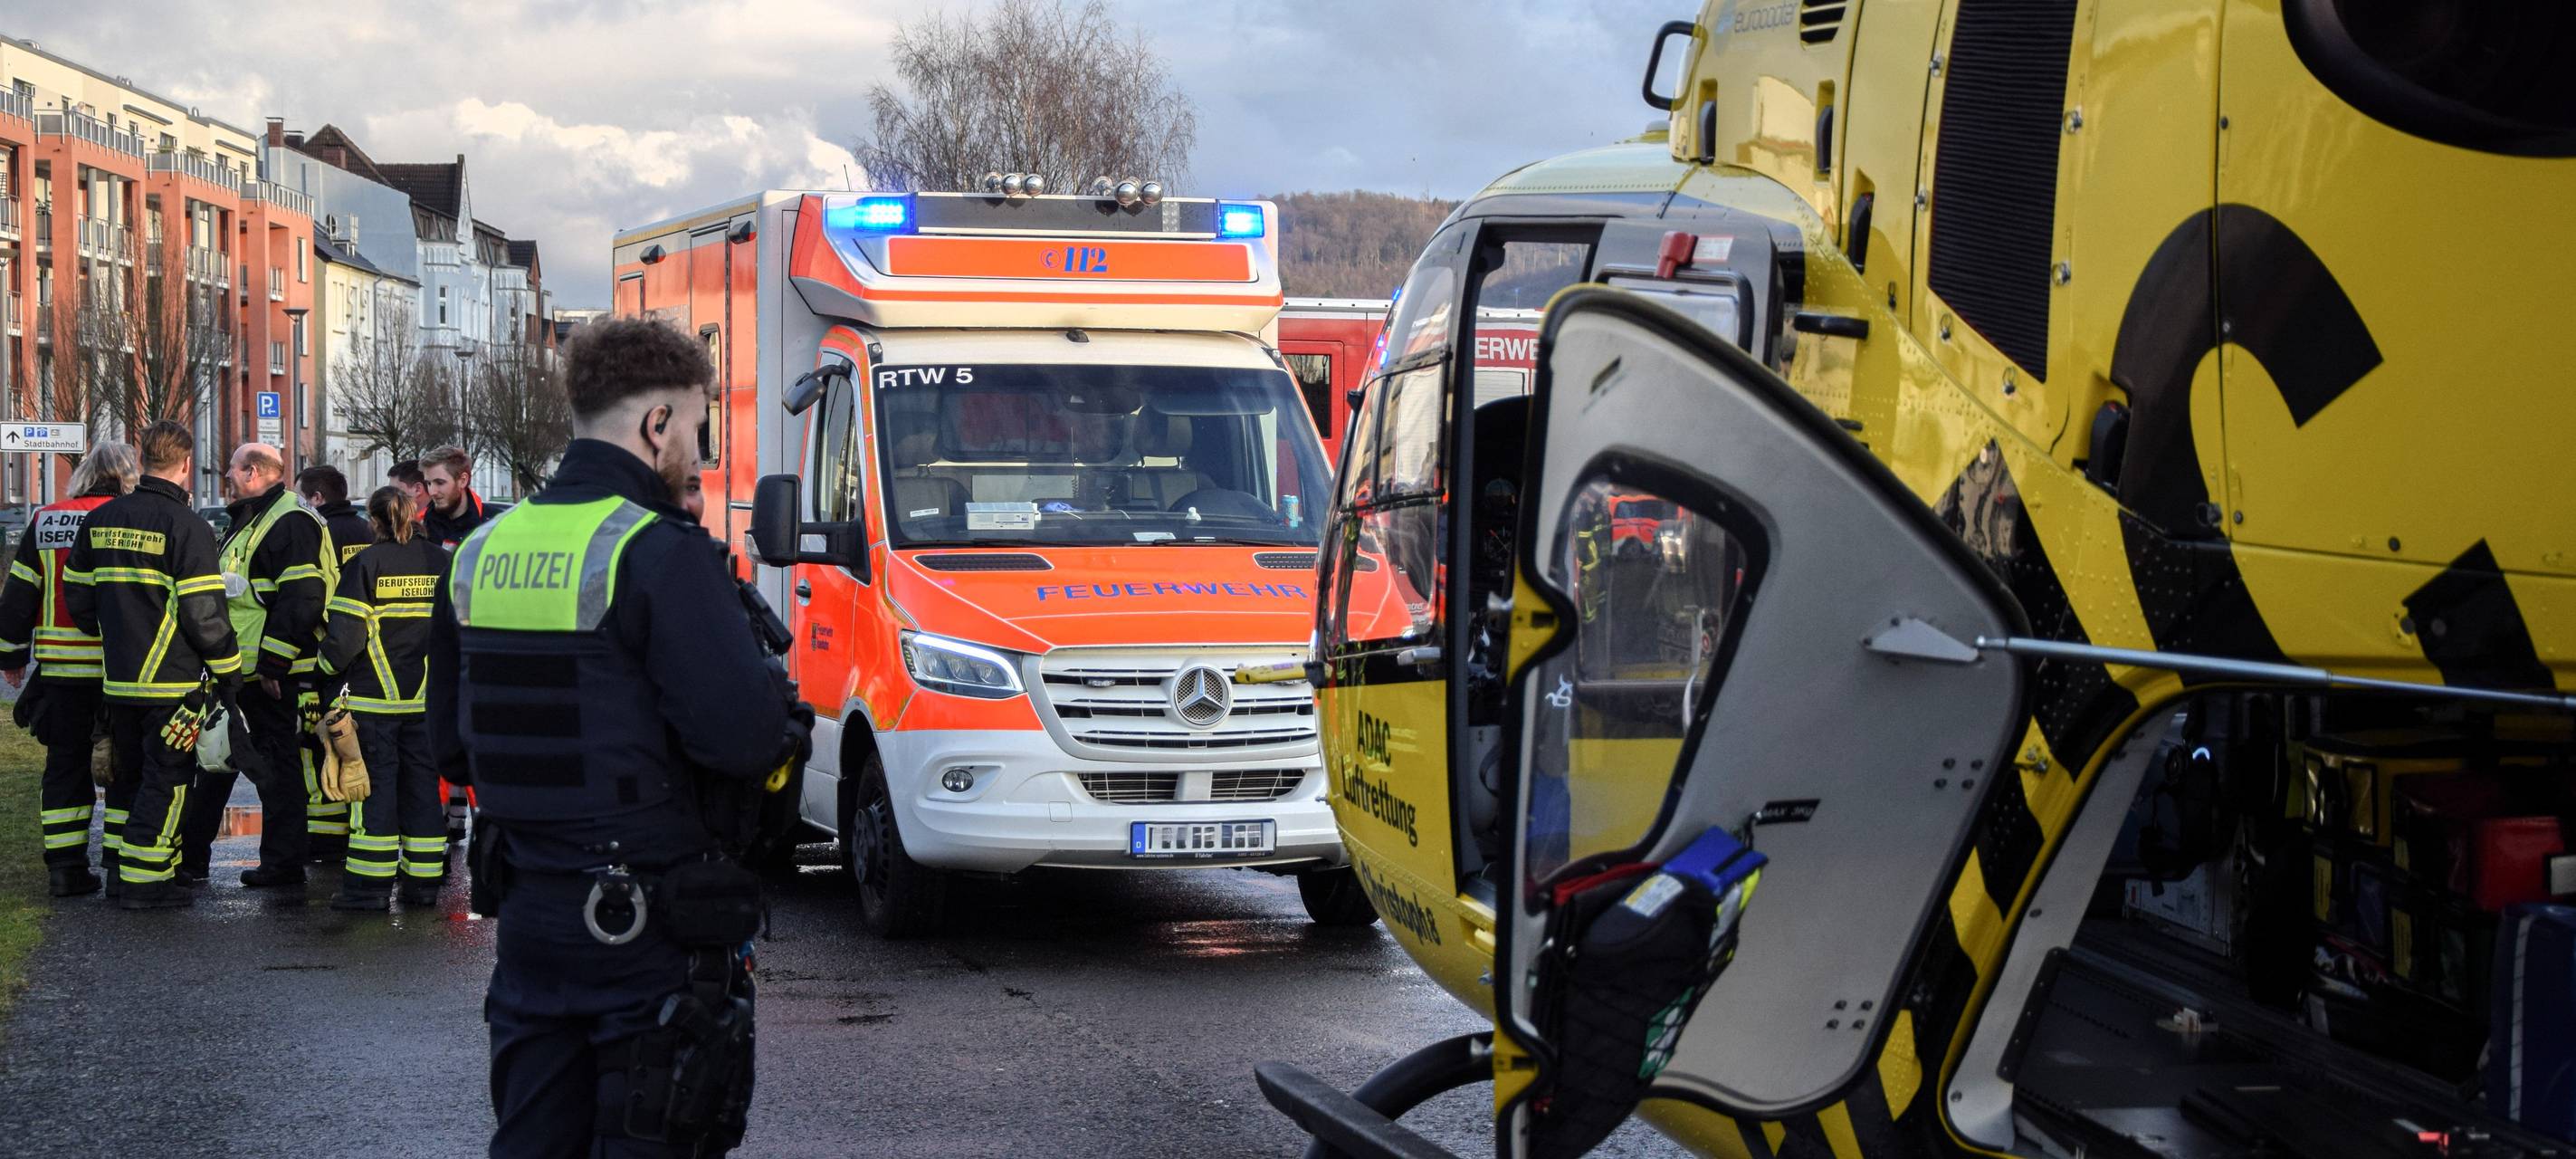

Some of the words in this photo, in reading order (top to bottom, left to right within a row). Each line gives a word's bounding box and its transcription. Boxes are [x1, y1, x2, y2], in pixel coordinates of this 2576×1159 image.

[1064, 245, 1109, 273] 112
[1474, 337, 1540, 360] ERWE
[879, 367, 946, 388] RTW
[956, 368, 973, 384] 5
[24, 440, 79, 448] Stadtbahnhof
[39, 530, 74, 543] ISER
[91, 529, 164, 543] Berufsfeuerwehr
[480, 552, 574, 589] POLIZEI
[378, 577, 437, 588] BERUFSFEUER
[1036, 582, 1308, 601] FEUERWEHR
[1358, 711, 1391, 766] ADAC
[1341, 754, 1418, 848] Luftrettung
